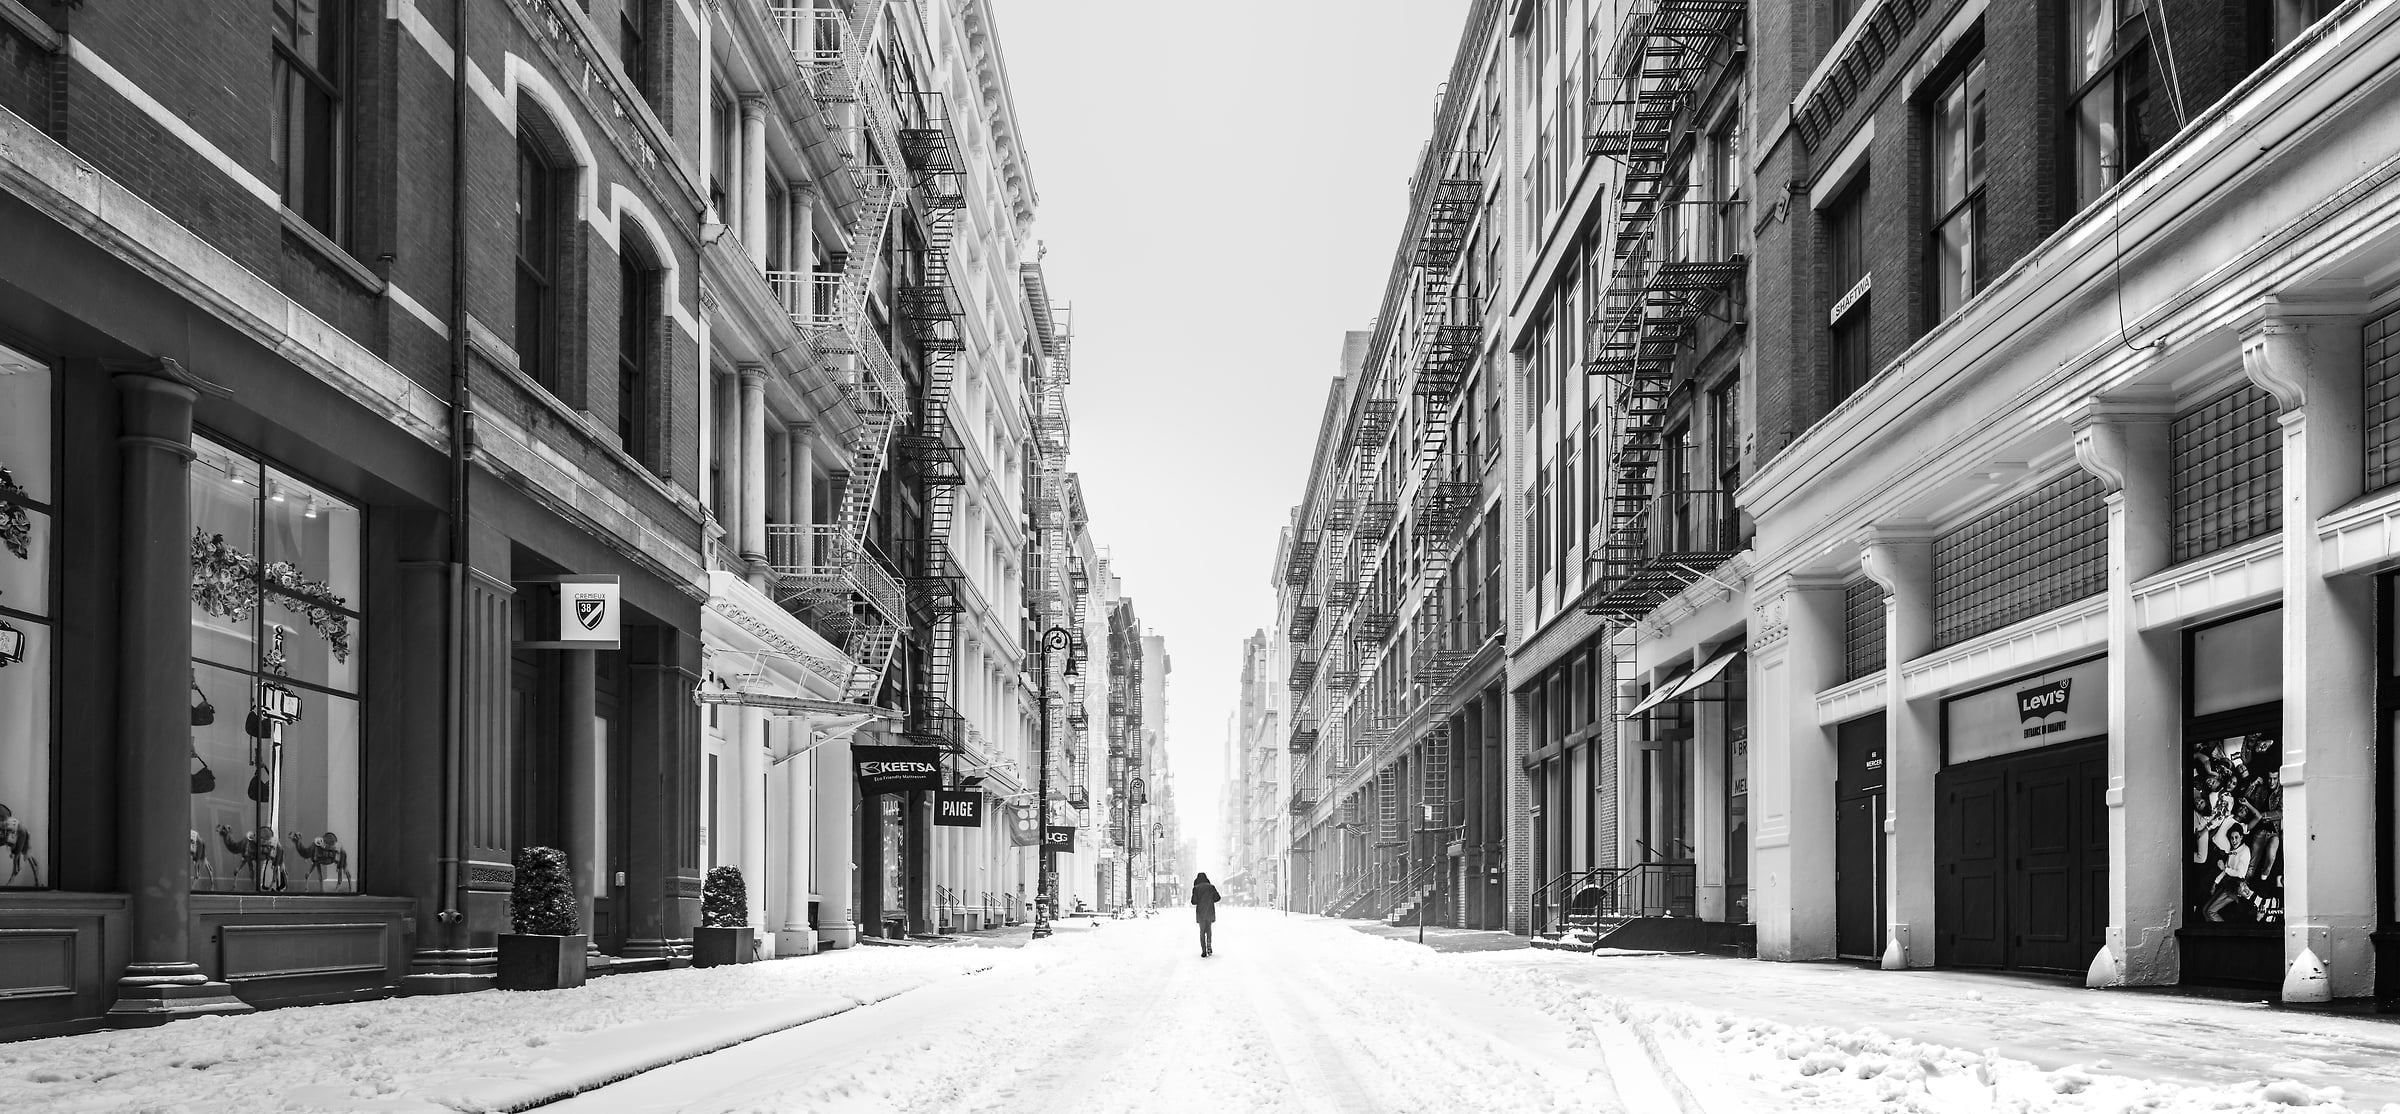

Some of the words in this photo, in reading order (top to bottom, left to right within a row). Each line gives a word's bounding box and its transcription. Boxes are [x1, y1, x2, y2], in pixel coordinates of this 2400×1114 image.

[1835, 276, 1870, 317] SHAFTWA
[581, 603, 592, 613] 38
[880, 761, 937, 773] KEETSA
[942, 800, 974, 817] PAIGE
